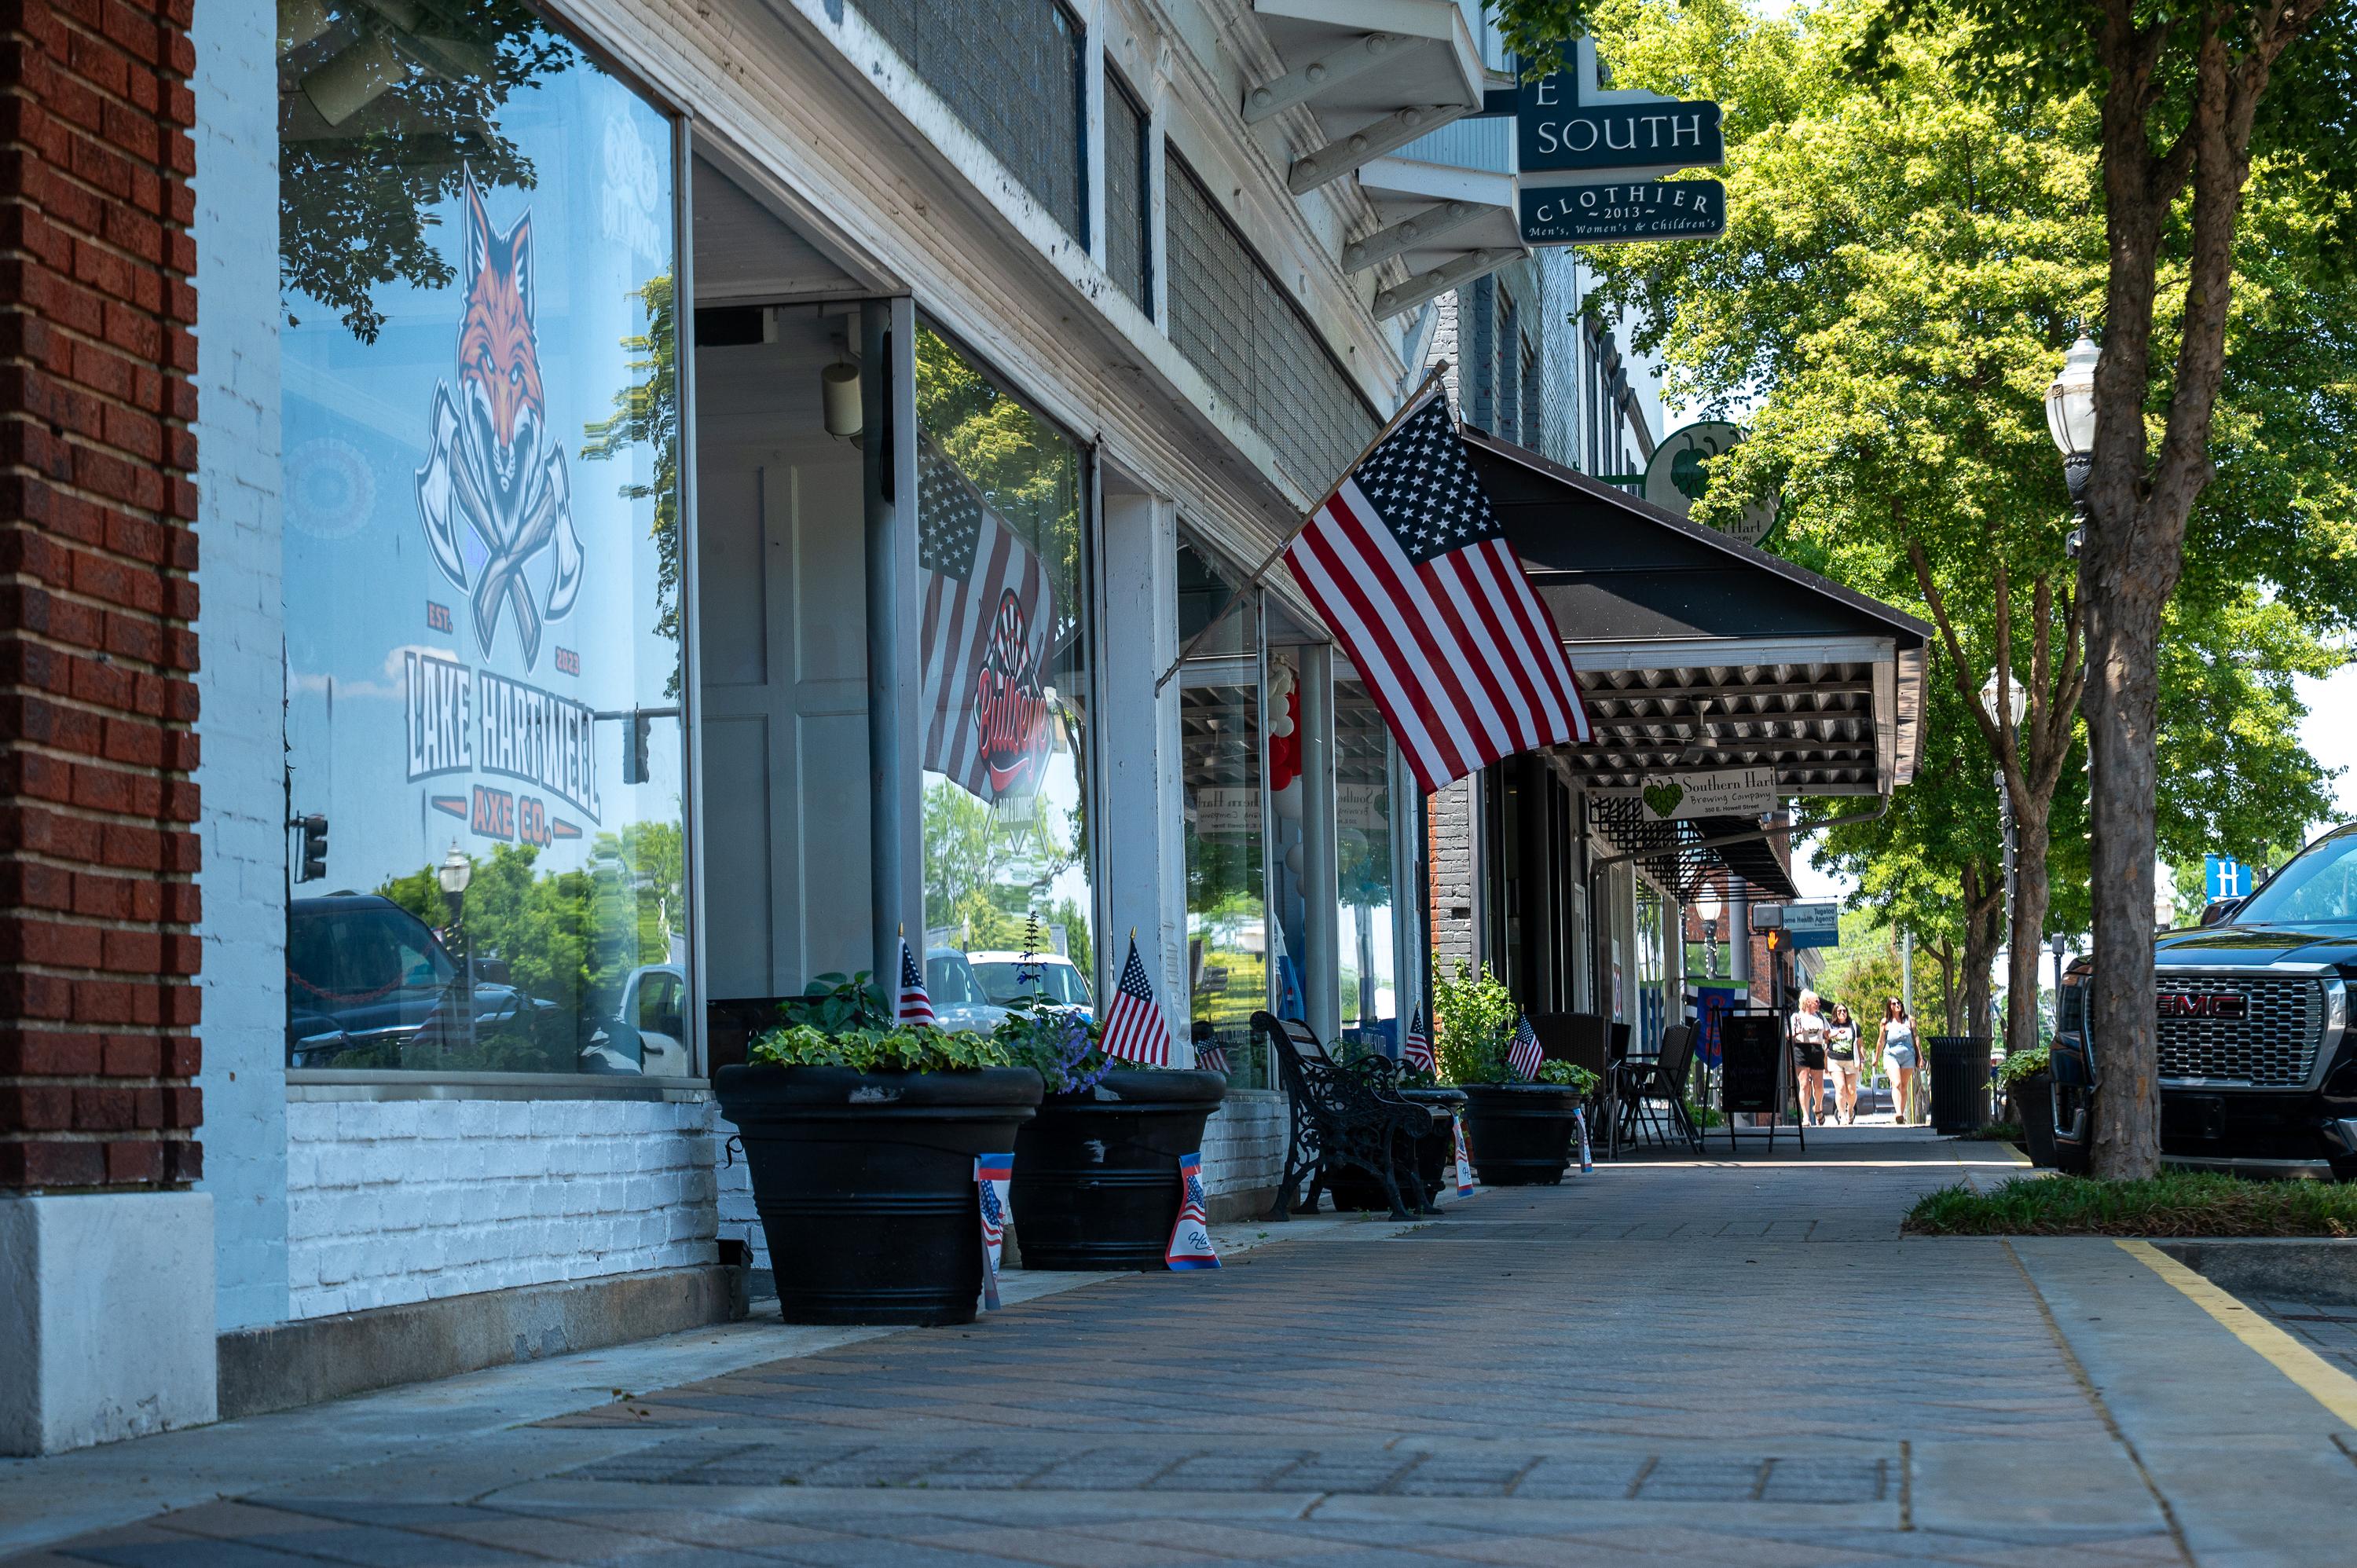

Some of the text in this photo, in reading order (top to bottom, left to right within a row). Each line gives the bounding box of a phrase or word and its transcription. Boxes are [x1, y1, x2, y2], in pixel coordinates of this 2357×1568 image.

[1538, 114, 1701, 154] SOUTH
[1537, 185, 1707, 222] CLOTHIER
[1604, 206, 1640, 219] 2013
[1529, 218, 1716, 237] Men's, Women's & Children's
[427, 600, 453, 634] EST.
[555, 647, 580, 677] 2023
[405, 652, 600, 826] LAKE HARTWELL
[978, 668, 1048, 784] Bullseye
[1683, 771, 1775, 793] Southern Hart
[999, 797, 1010, 823] BAR
[1690, 792, 1771, 805] Brewing Company
[471, 785, 552, 849] AXE CO.
[2216, 861, 2239, 896] H
[1814, 907, 1835, 916] Tugaloo
